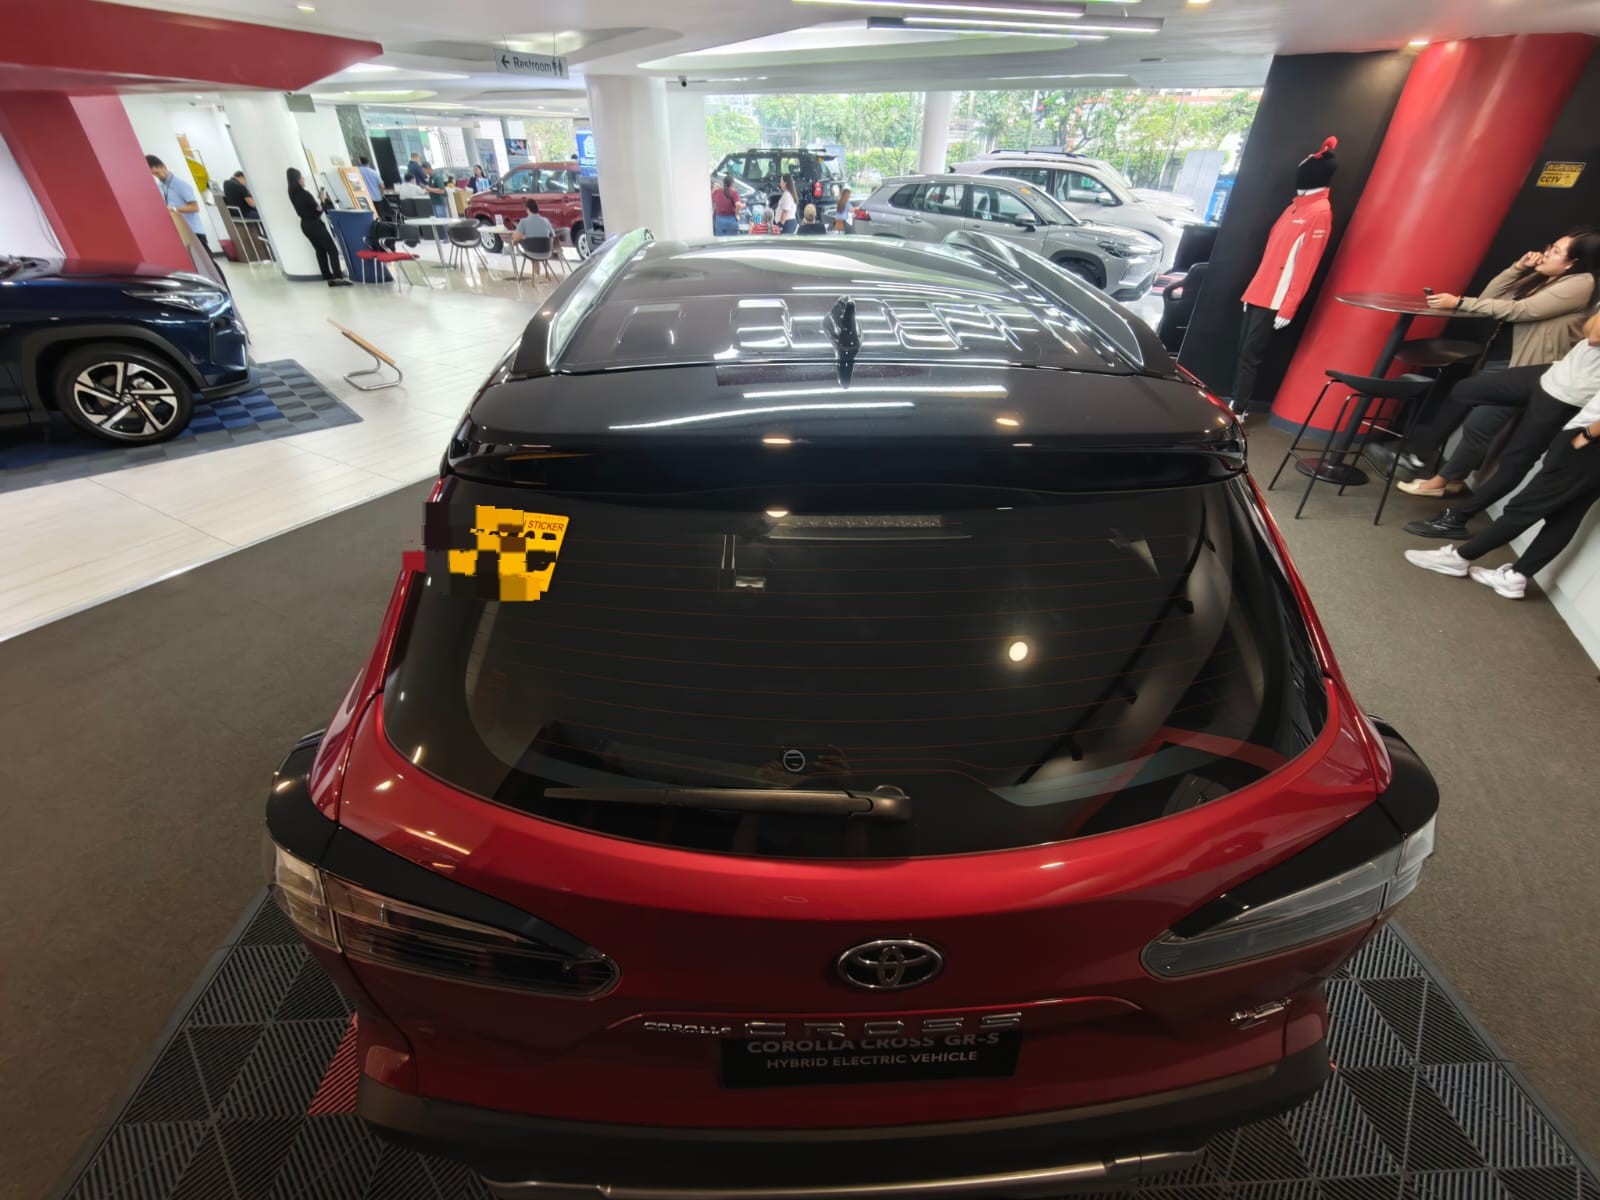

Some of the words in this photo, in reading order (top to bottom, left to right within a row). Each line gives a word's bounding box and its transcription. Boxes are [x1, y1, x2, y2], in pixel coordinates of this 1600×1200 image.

[513, 56, 552, 72] Restroom
[527, 520, 564, 532] STICKER
[744, 1012, 1022, 1037] CROSS
[747, 1039, 855, 1053] COROLLA
[861, 1037, 935, 1049] CROSS
[944, 1032, 1000, 1046] GR-S
[767, 1056, 828, 1069] HYBRID
[833, 1053, 906, 1067] ELECTRIC
[911, 1051, 977, 1063] VEHICLE
